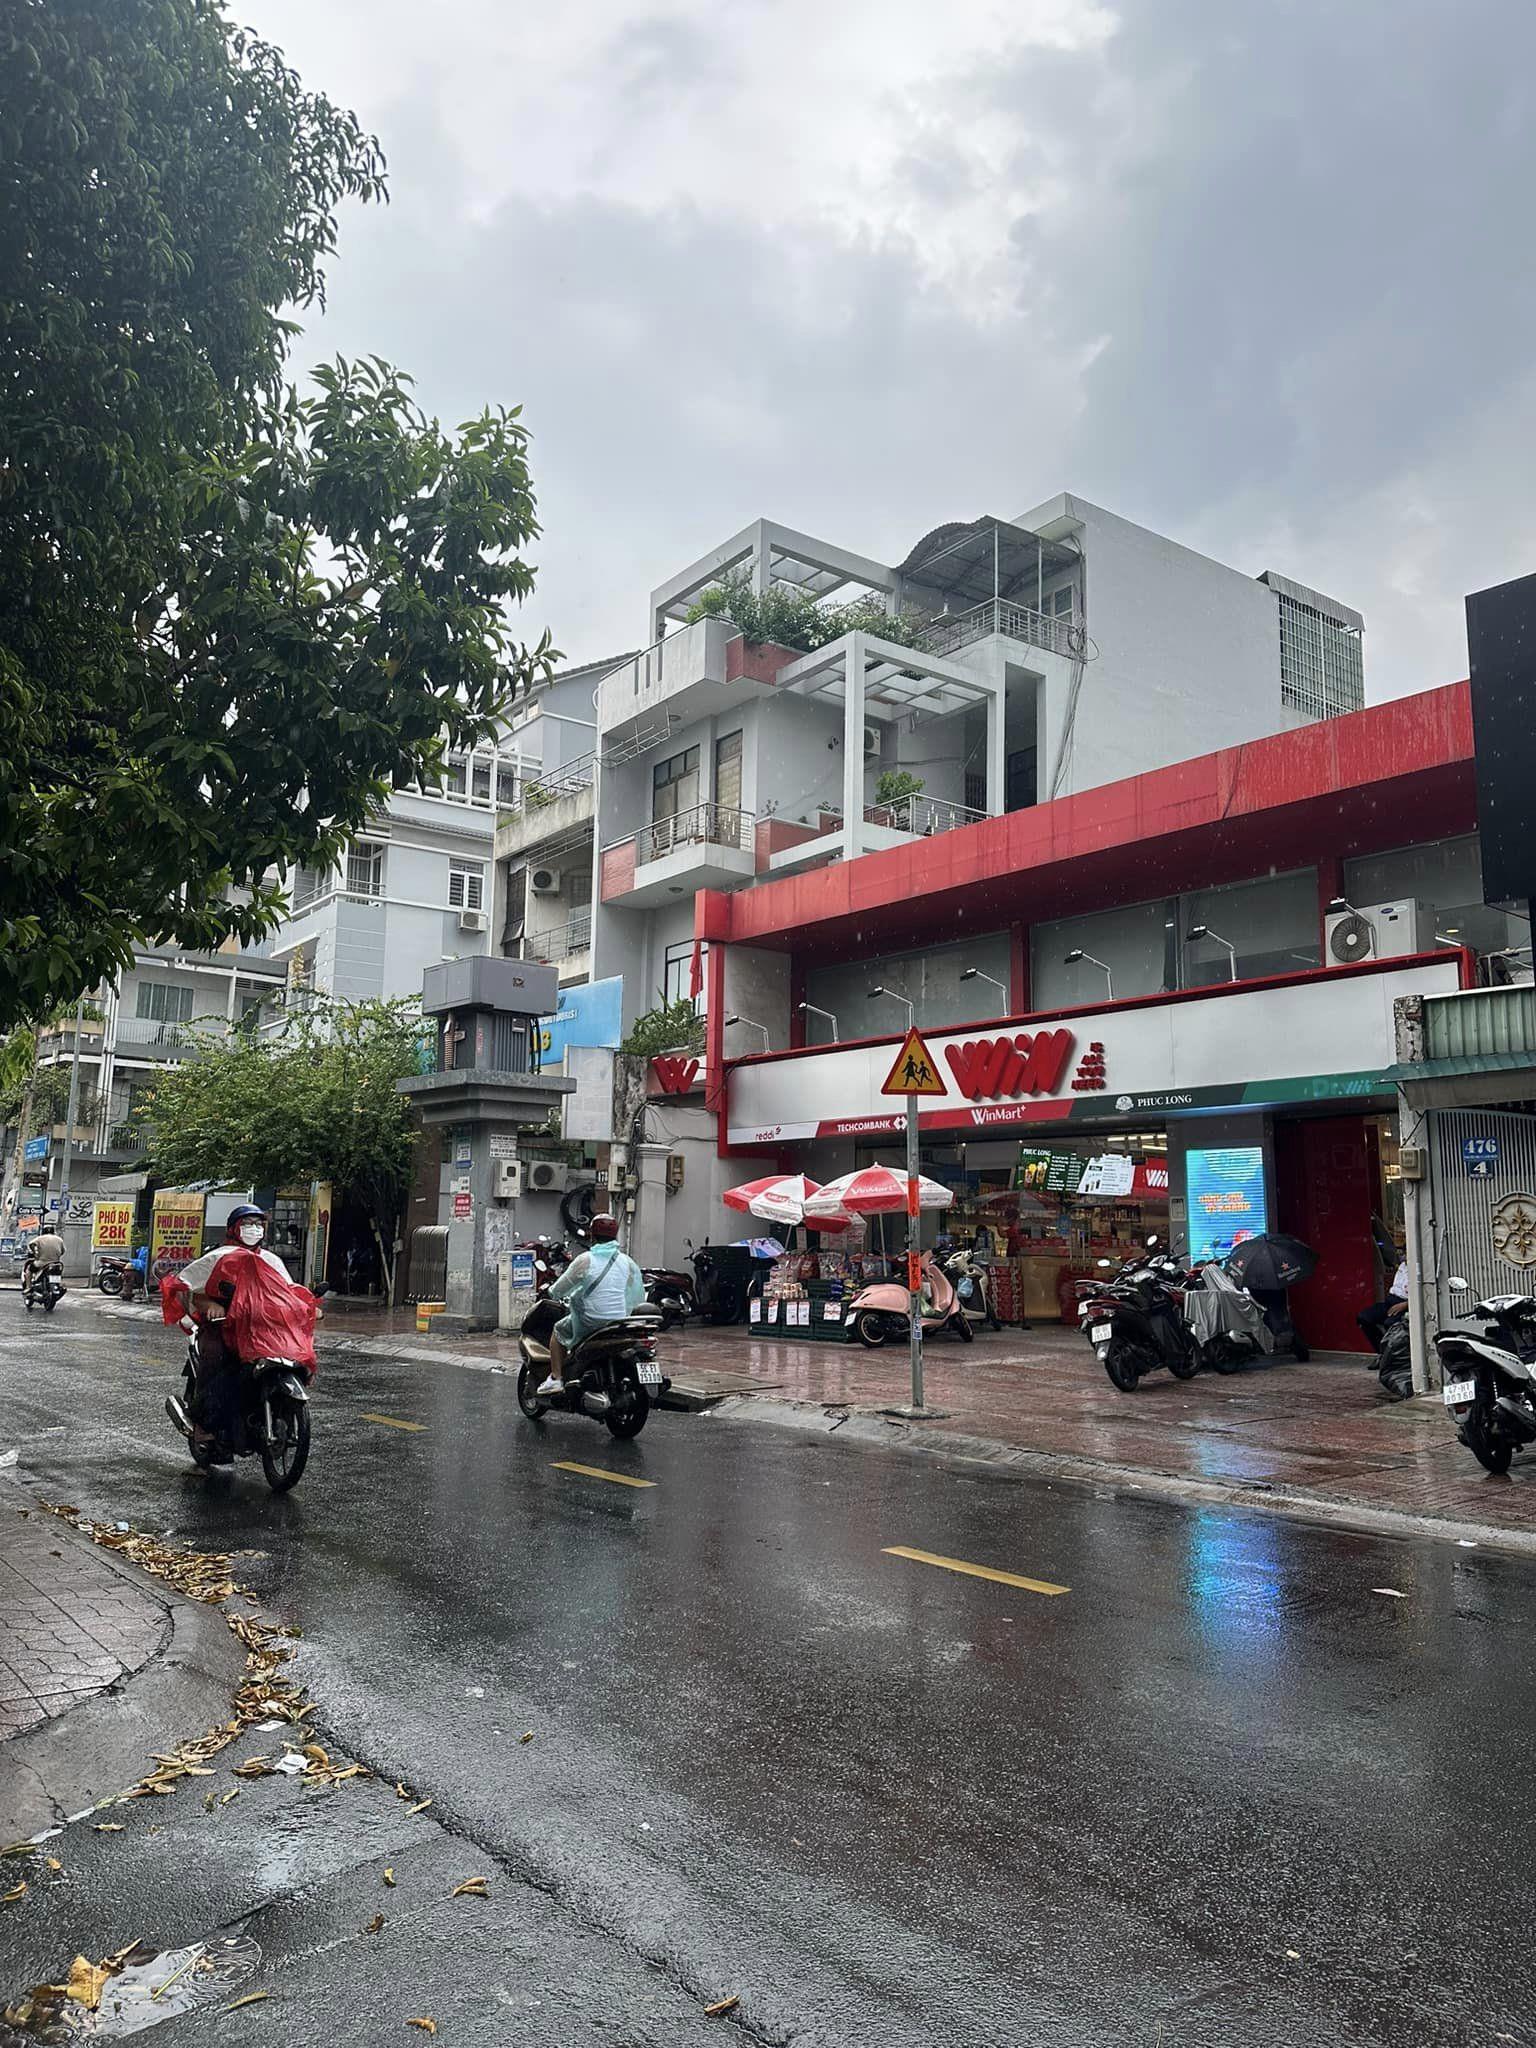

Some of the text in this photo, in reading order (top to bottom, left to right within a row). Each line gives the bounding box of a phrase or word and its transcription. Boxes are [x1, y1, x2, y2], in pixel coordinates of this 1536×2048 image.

[1137, 1094, 1192, 1107] PHUC LONG
[837, 1119, 891, 1133] TECHCOMBANK
[1465, 1138, 1497, 1154] 476
[1473, 1161, 1489, 1174] 4
